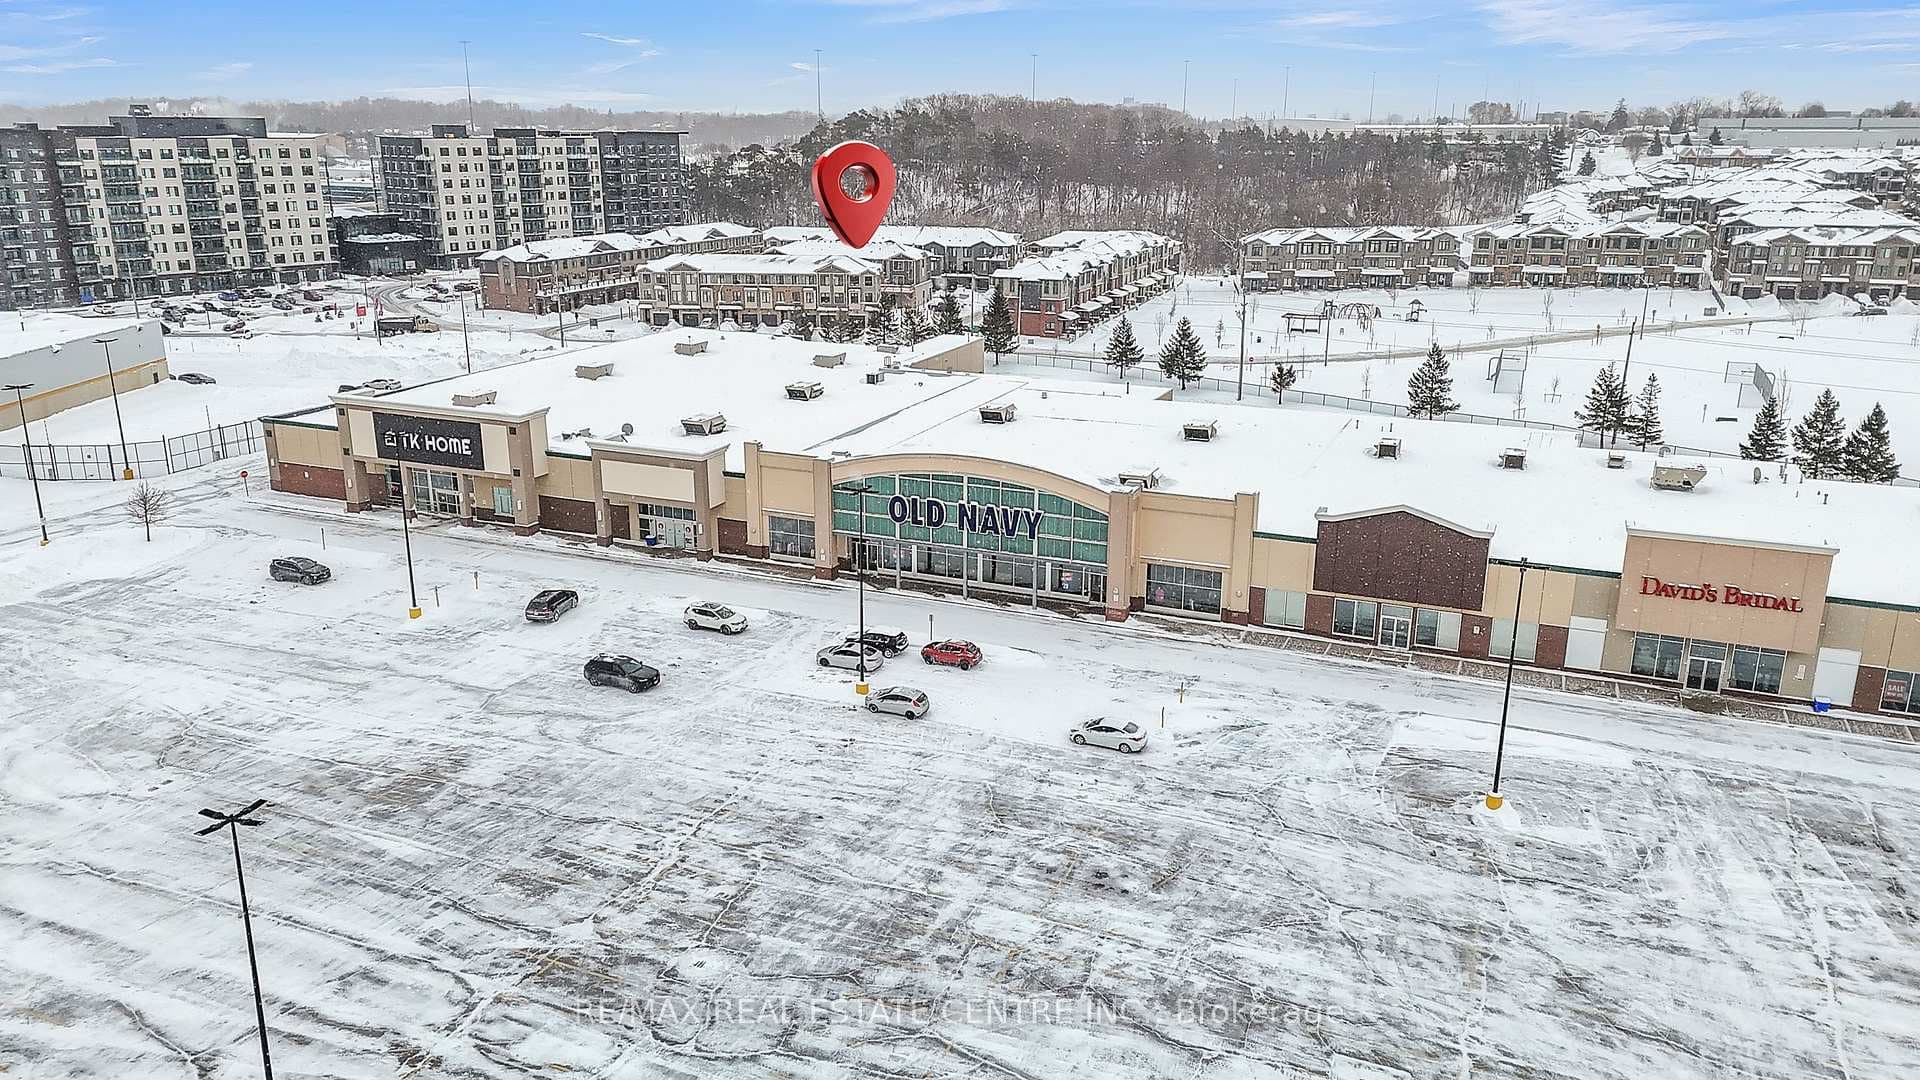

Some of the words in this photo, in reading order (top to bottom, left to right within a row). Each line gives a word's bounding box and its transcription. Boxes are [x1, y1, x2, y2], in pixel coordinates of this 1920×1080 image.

[399, 431, 421, 450] TK
[424, 434, 472, 455] HOME
[888, 494, 946, 528] OLD
[957, 500, 1044, 540] NAVY
